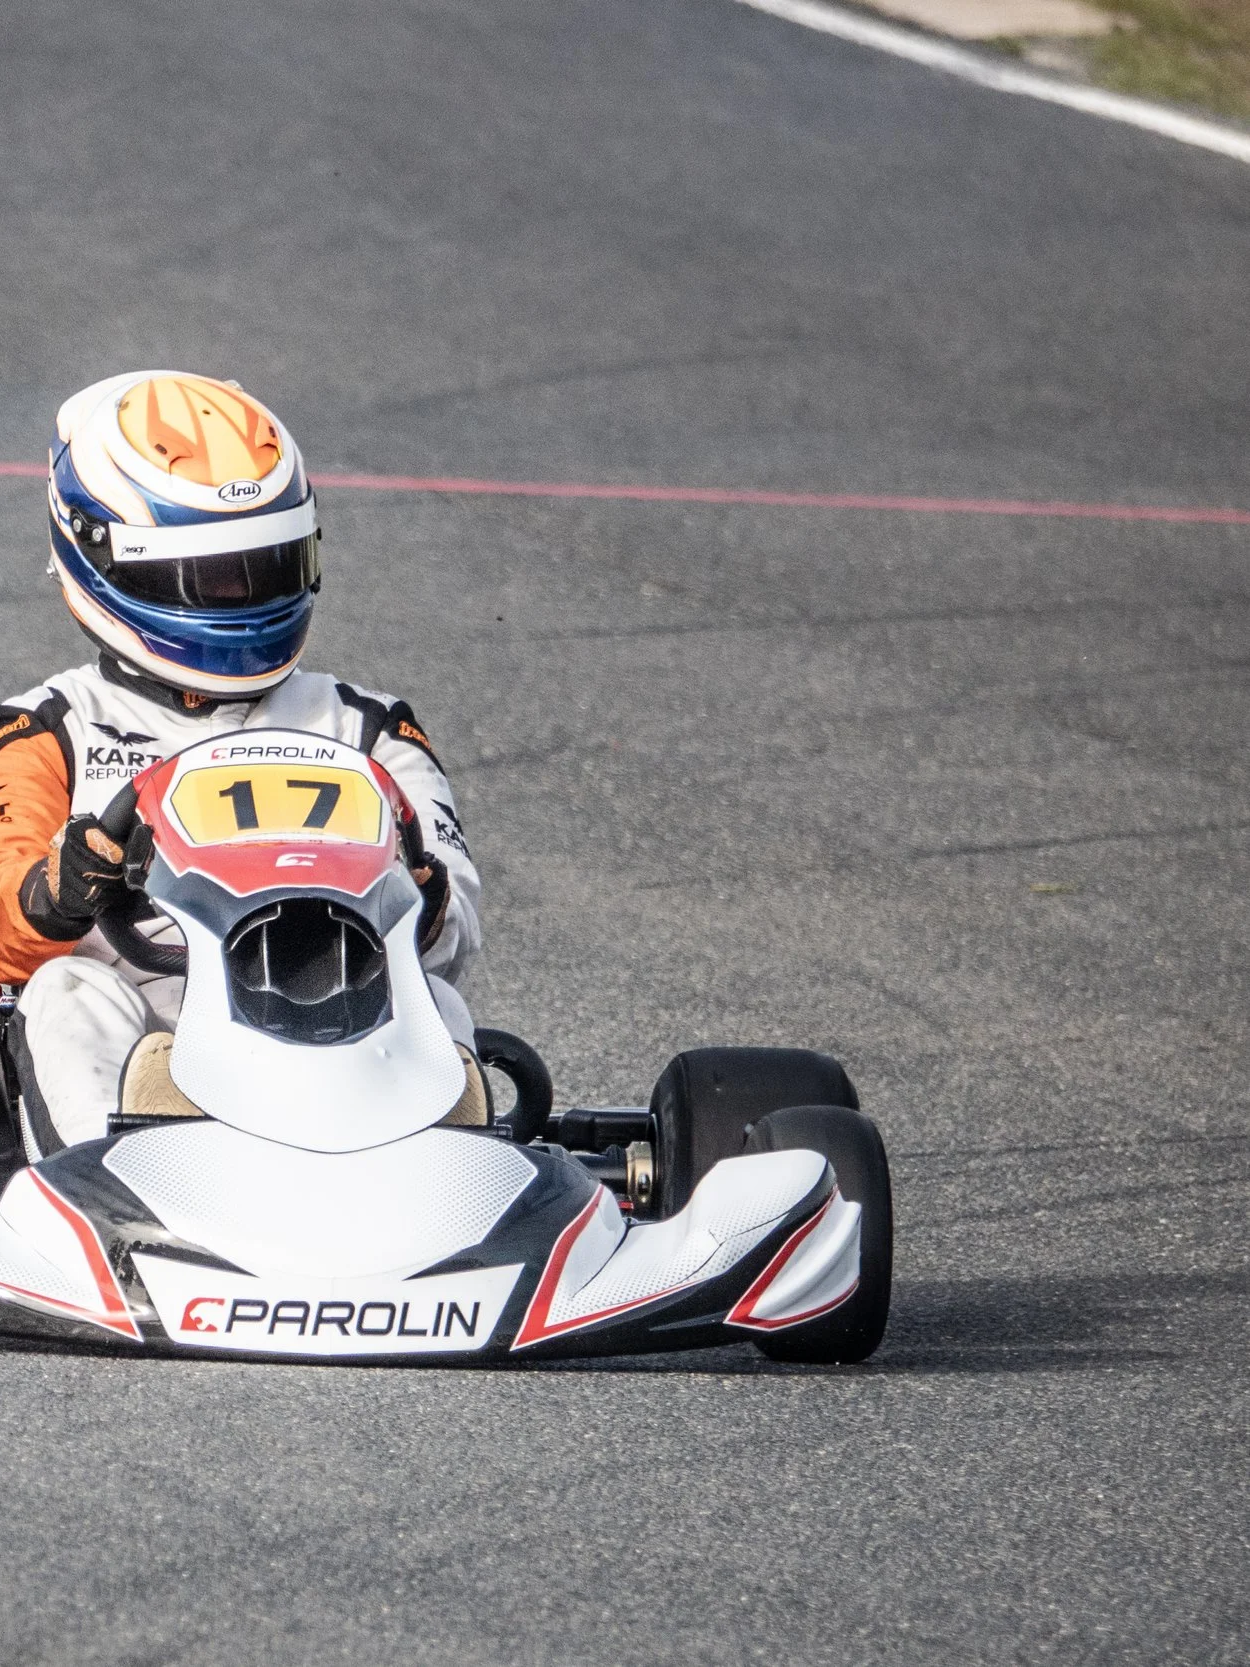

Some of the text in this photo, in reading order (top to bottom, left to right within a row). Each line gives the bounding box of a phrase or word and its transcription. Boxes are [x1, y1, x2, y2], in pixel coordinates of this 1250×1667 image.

[227, 483, 258, 498] Arai
[86, 747, 162, 768] KART
[229, 746, 336, 760] PAROLIN
[85, 768, 144, 780] REPUB
[219, 779, 342, 830] 17
[225, 1298, 481, 1337] PAROLIN
